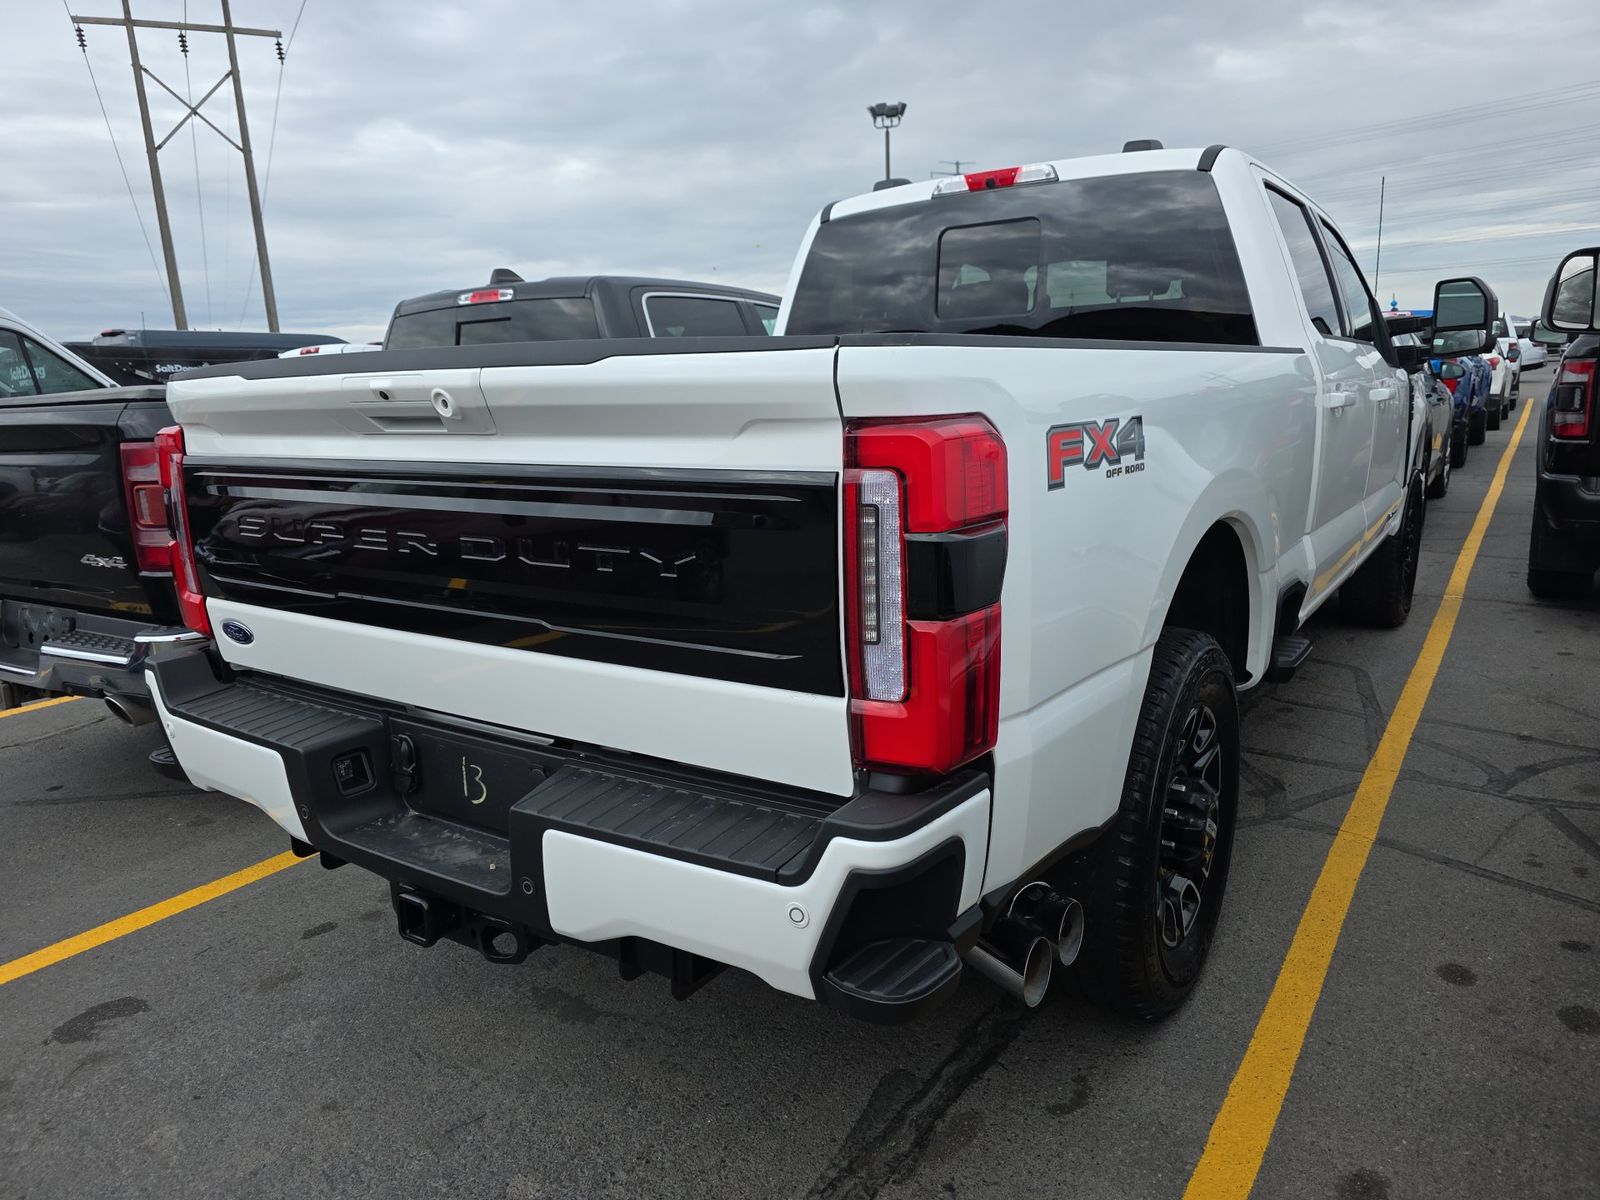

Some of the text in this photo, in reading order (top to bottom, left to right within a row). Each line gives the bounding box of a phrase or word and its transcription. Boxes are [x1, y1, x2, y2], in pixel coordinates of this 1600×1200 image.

[1046, 415, 1145, 491] FX4
[1106, 462, 1146, 478] OFF ROAD
[238, 515, 697, 578] SUPER DUTY
